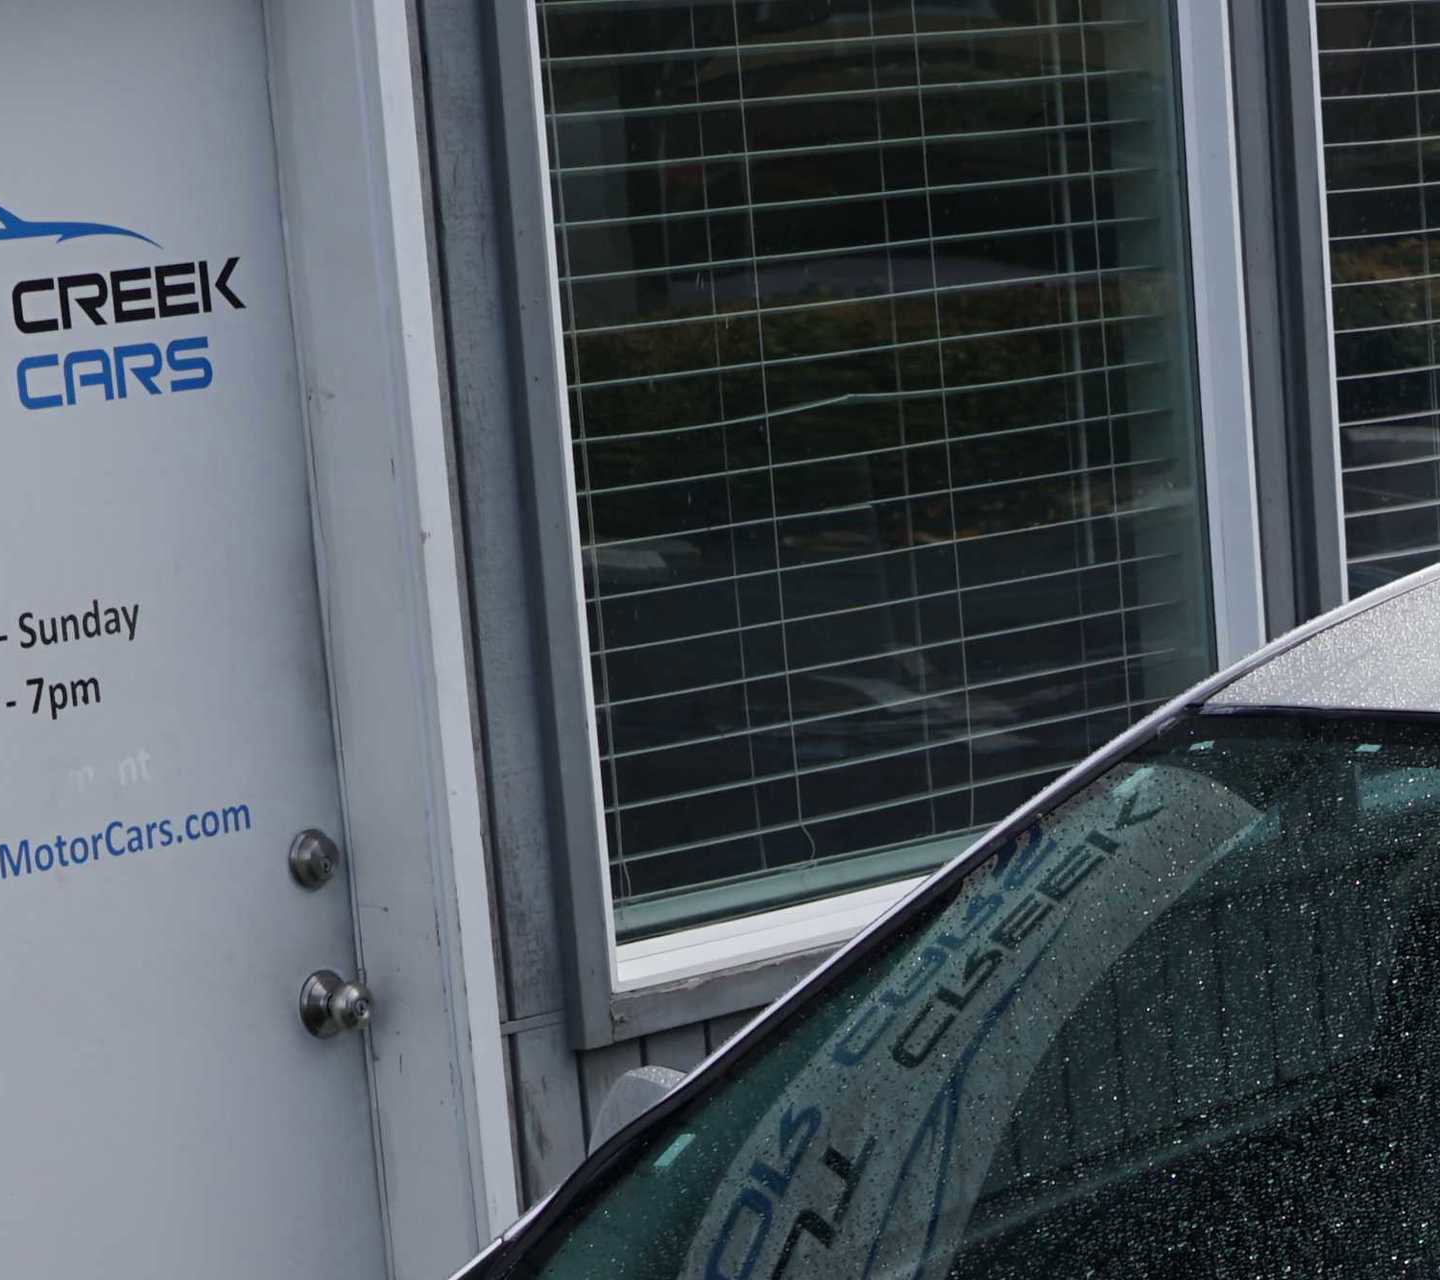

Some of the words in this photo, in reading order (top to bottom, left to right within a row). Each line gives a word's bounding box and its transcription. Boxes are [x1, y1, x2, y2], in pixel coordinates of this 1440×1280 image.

[11, 256, 247, 335] CREEK
[16, 336, 213, 411] CARS
[17, 599, 140, 650] Sunday
[25, 675, 102, 721] 7pm
